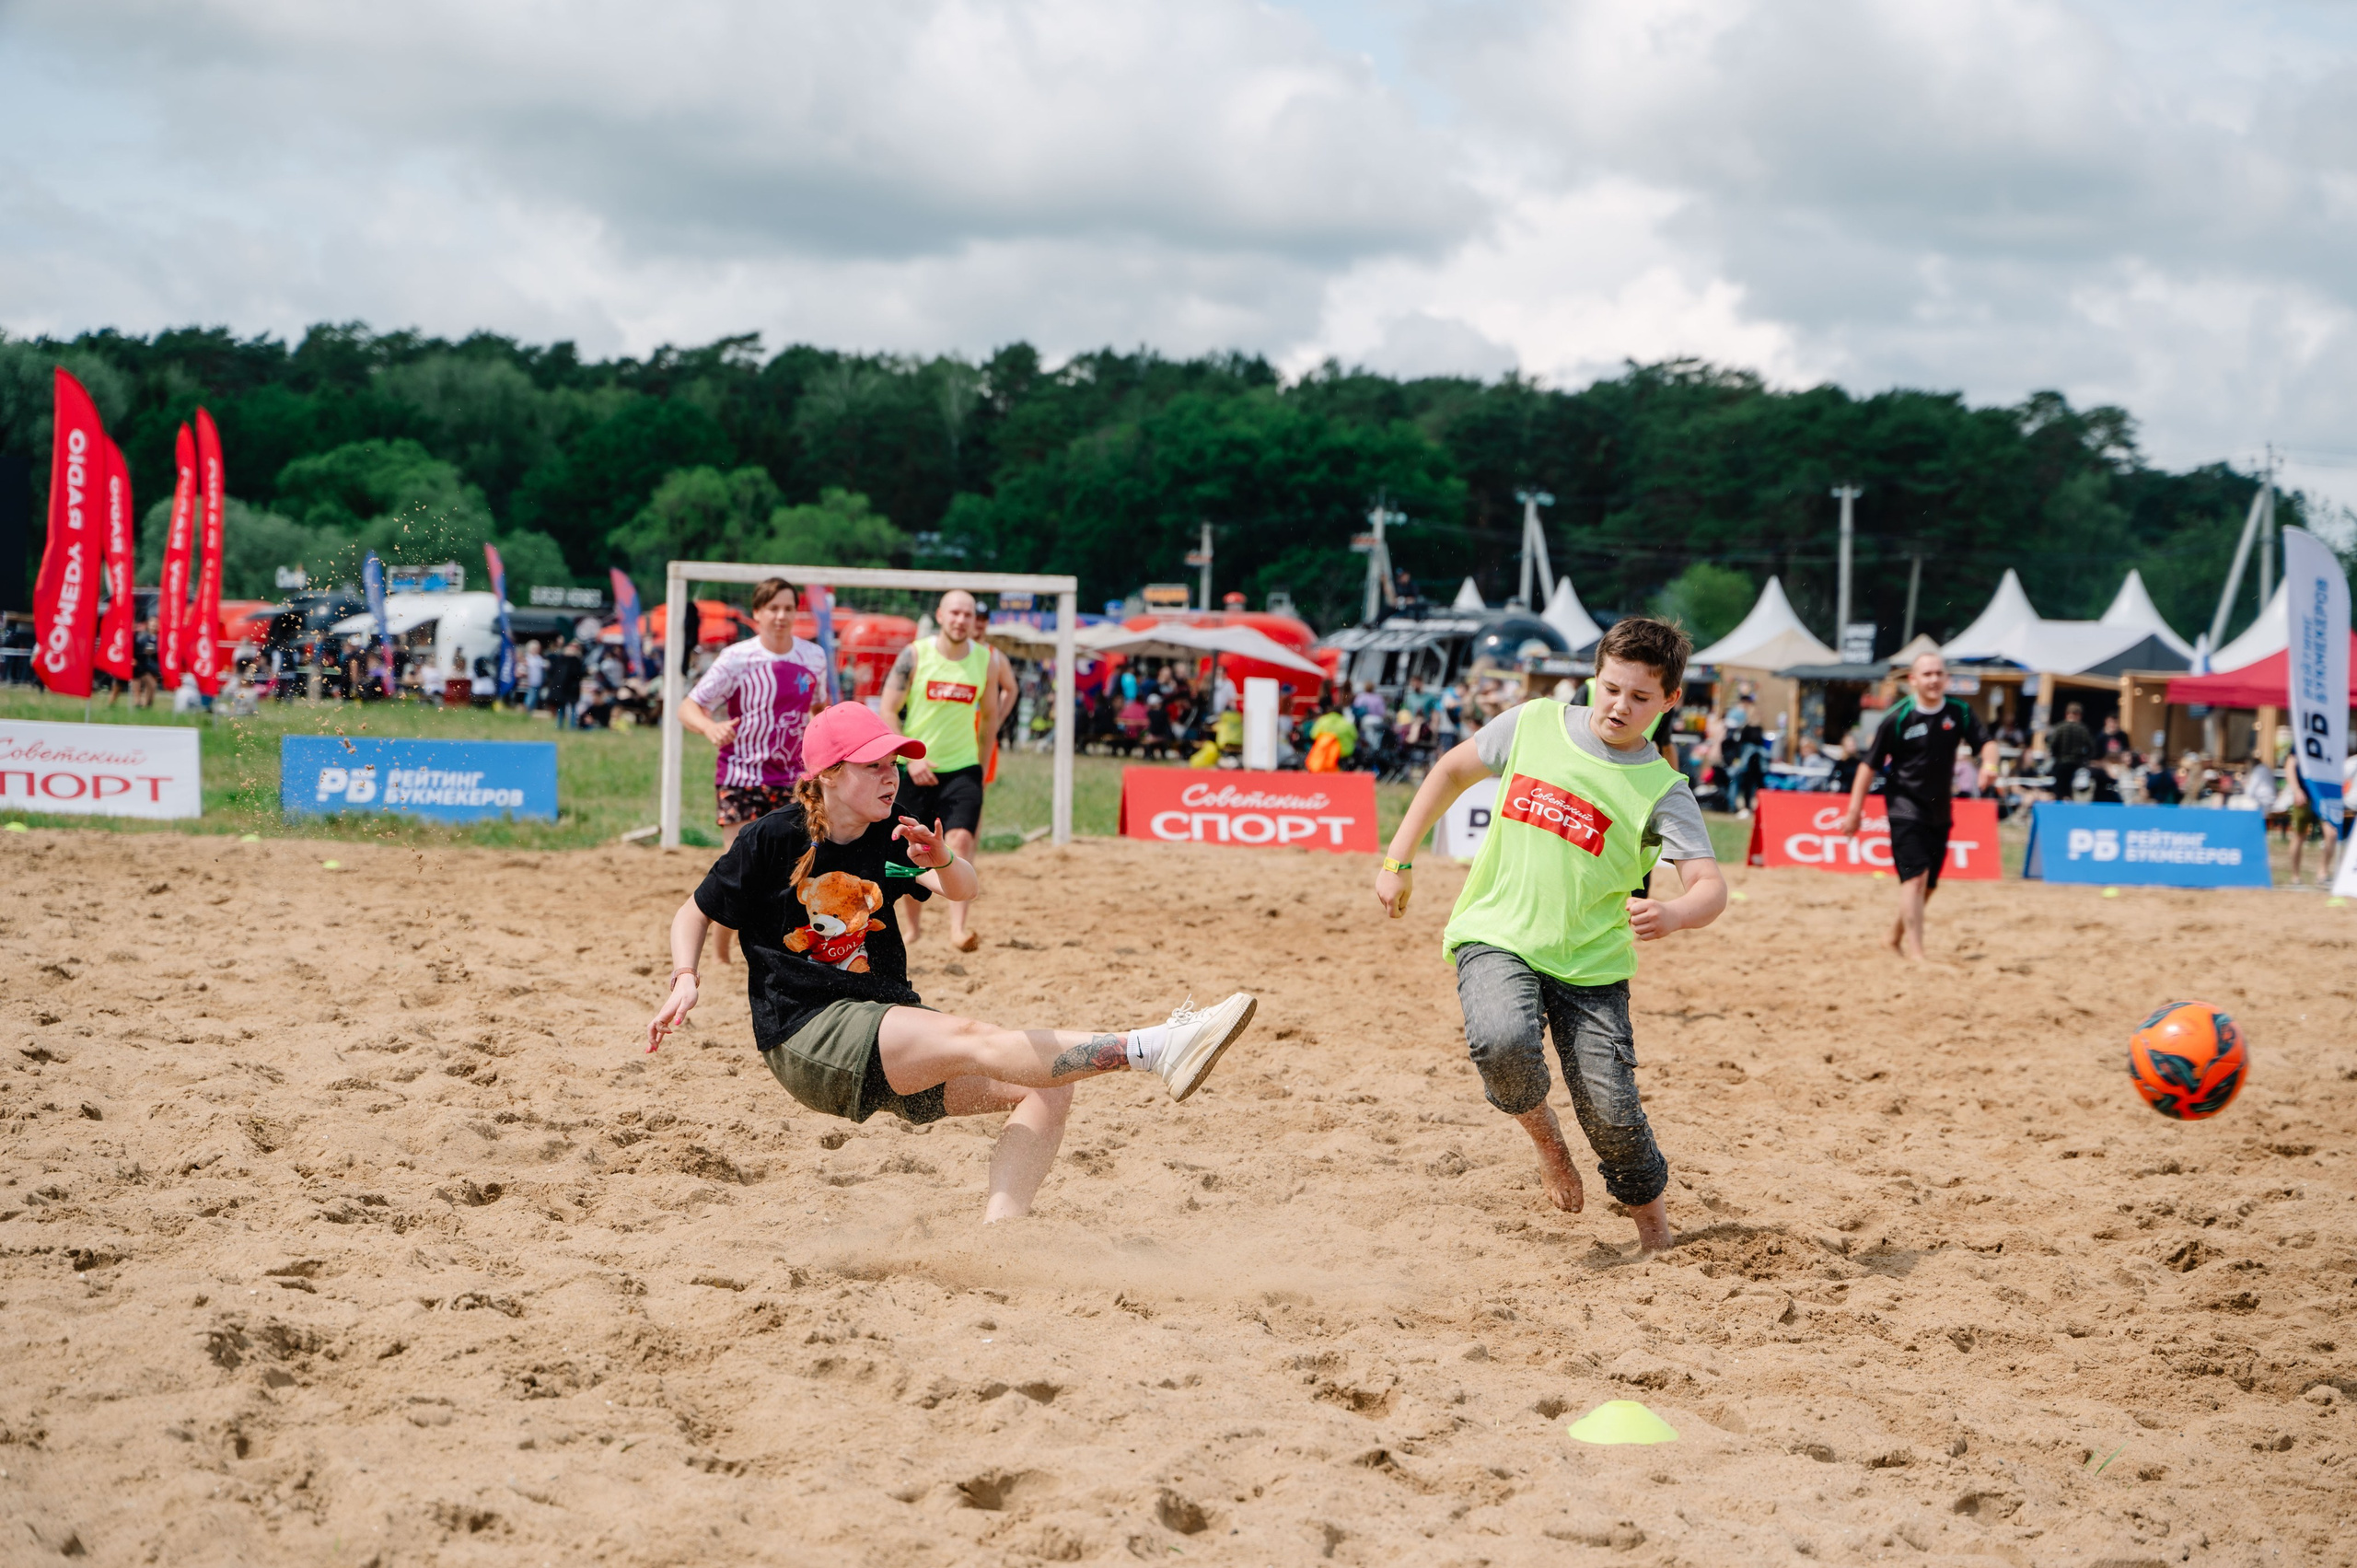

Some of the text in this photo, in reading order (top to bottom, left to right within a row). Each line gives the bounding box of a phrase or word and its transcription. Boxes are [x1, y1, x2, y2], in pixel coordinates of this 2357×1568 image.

[44, 428, 87, 673] COMEDY RADIO
[0, 770, 173, 803] ПОРТ
[386, 769, 484, 788] РЕЙТИНГ
[384, 787, 524, 807] БУКМЕКЕРОВ
[1181, 783, 1330, 810] Советский
[1530, 787, 1594, 821] Советский
[1151, 811, 1355, 845] СПОРТ
[1513, 796, 1600, 840] СПОРТ
[1784, 832, 1979, 869] СПОТ
[828, 941, 858, 958] GOAL
